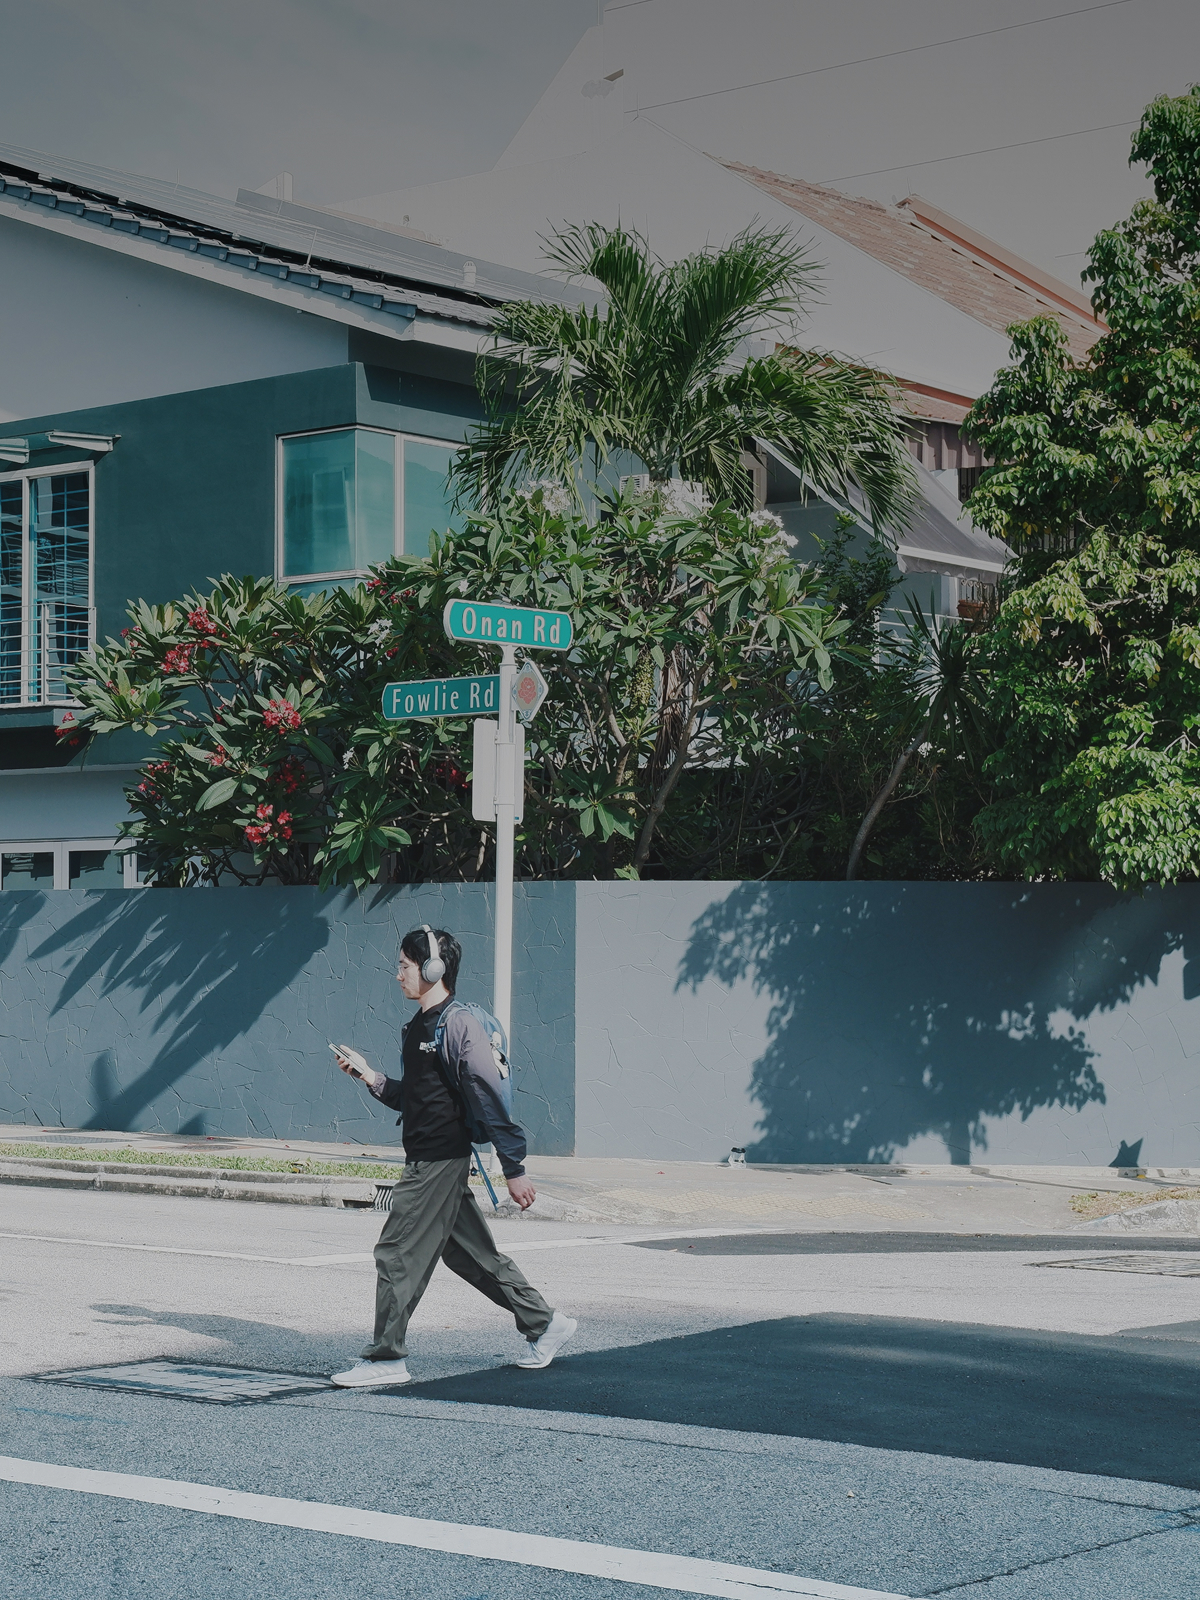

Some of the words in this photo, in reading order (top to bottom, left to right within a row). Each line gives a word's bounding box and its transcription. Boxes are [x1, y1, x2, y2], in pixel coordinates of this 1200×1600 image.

[462, 607, 523, 640] Onan
[534, 615, 561, 645] Rd
[392, 685, 460, 714] Fowlie
[470, 681, 495, 709] Rd
